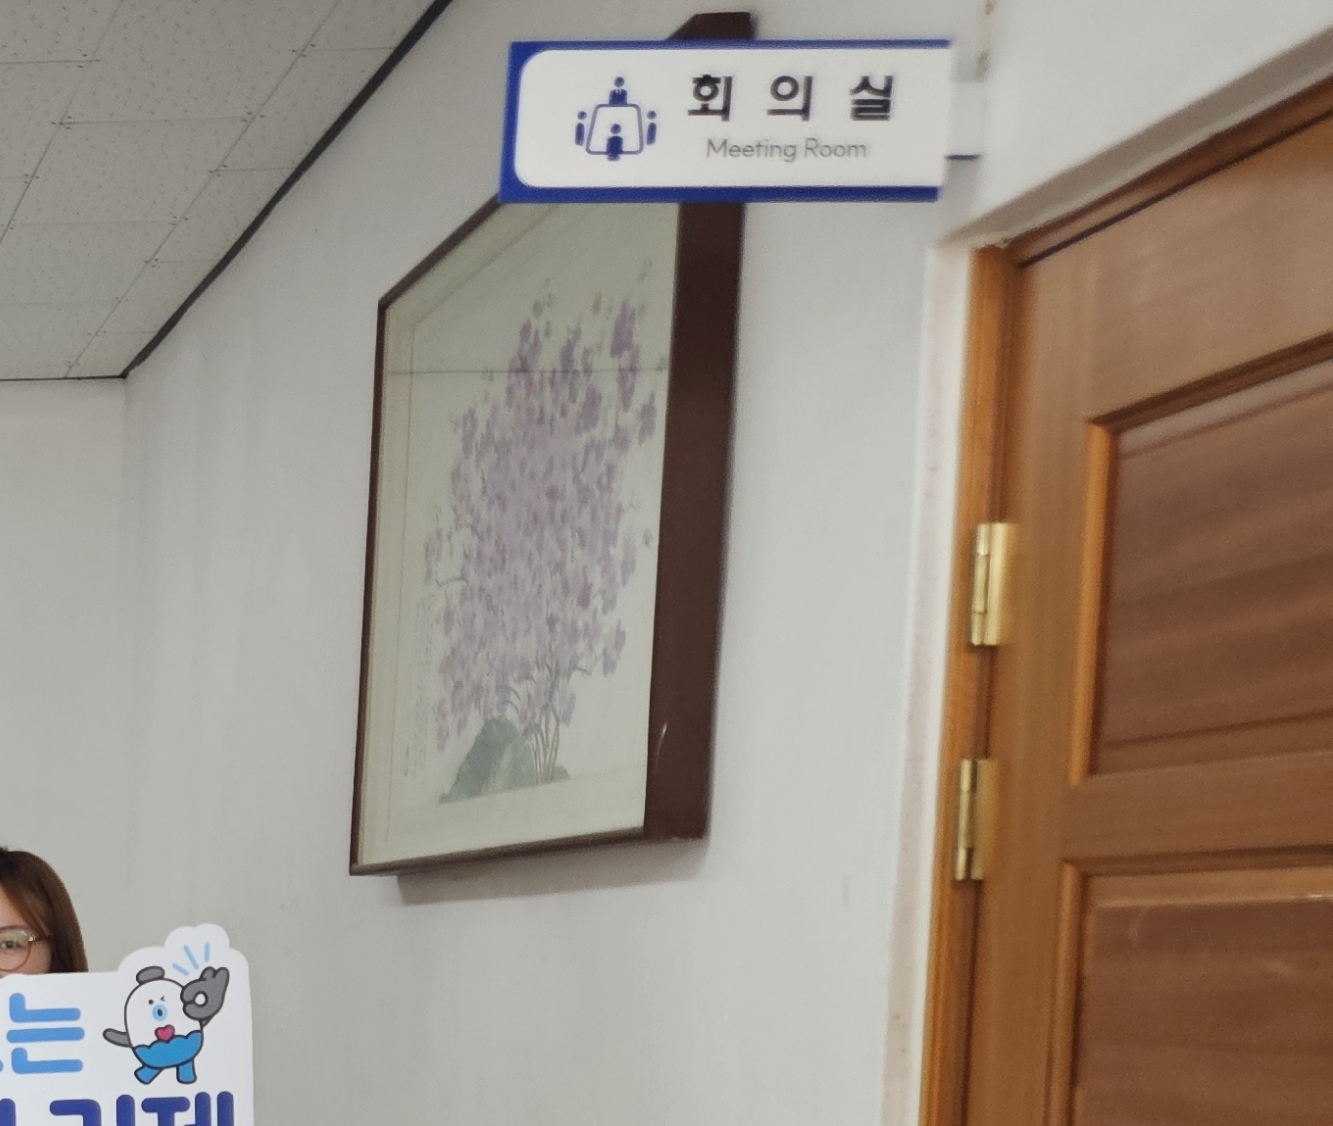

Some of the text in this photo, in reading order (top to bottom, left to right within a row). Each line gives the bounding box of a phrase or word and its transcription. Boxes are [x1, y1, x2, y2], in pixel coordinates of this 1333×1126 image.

[688, 74, 893, 121] 회의실
[707, 138, 867, 162] Meeting Room
